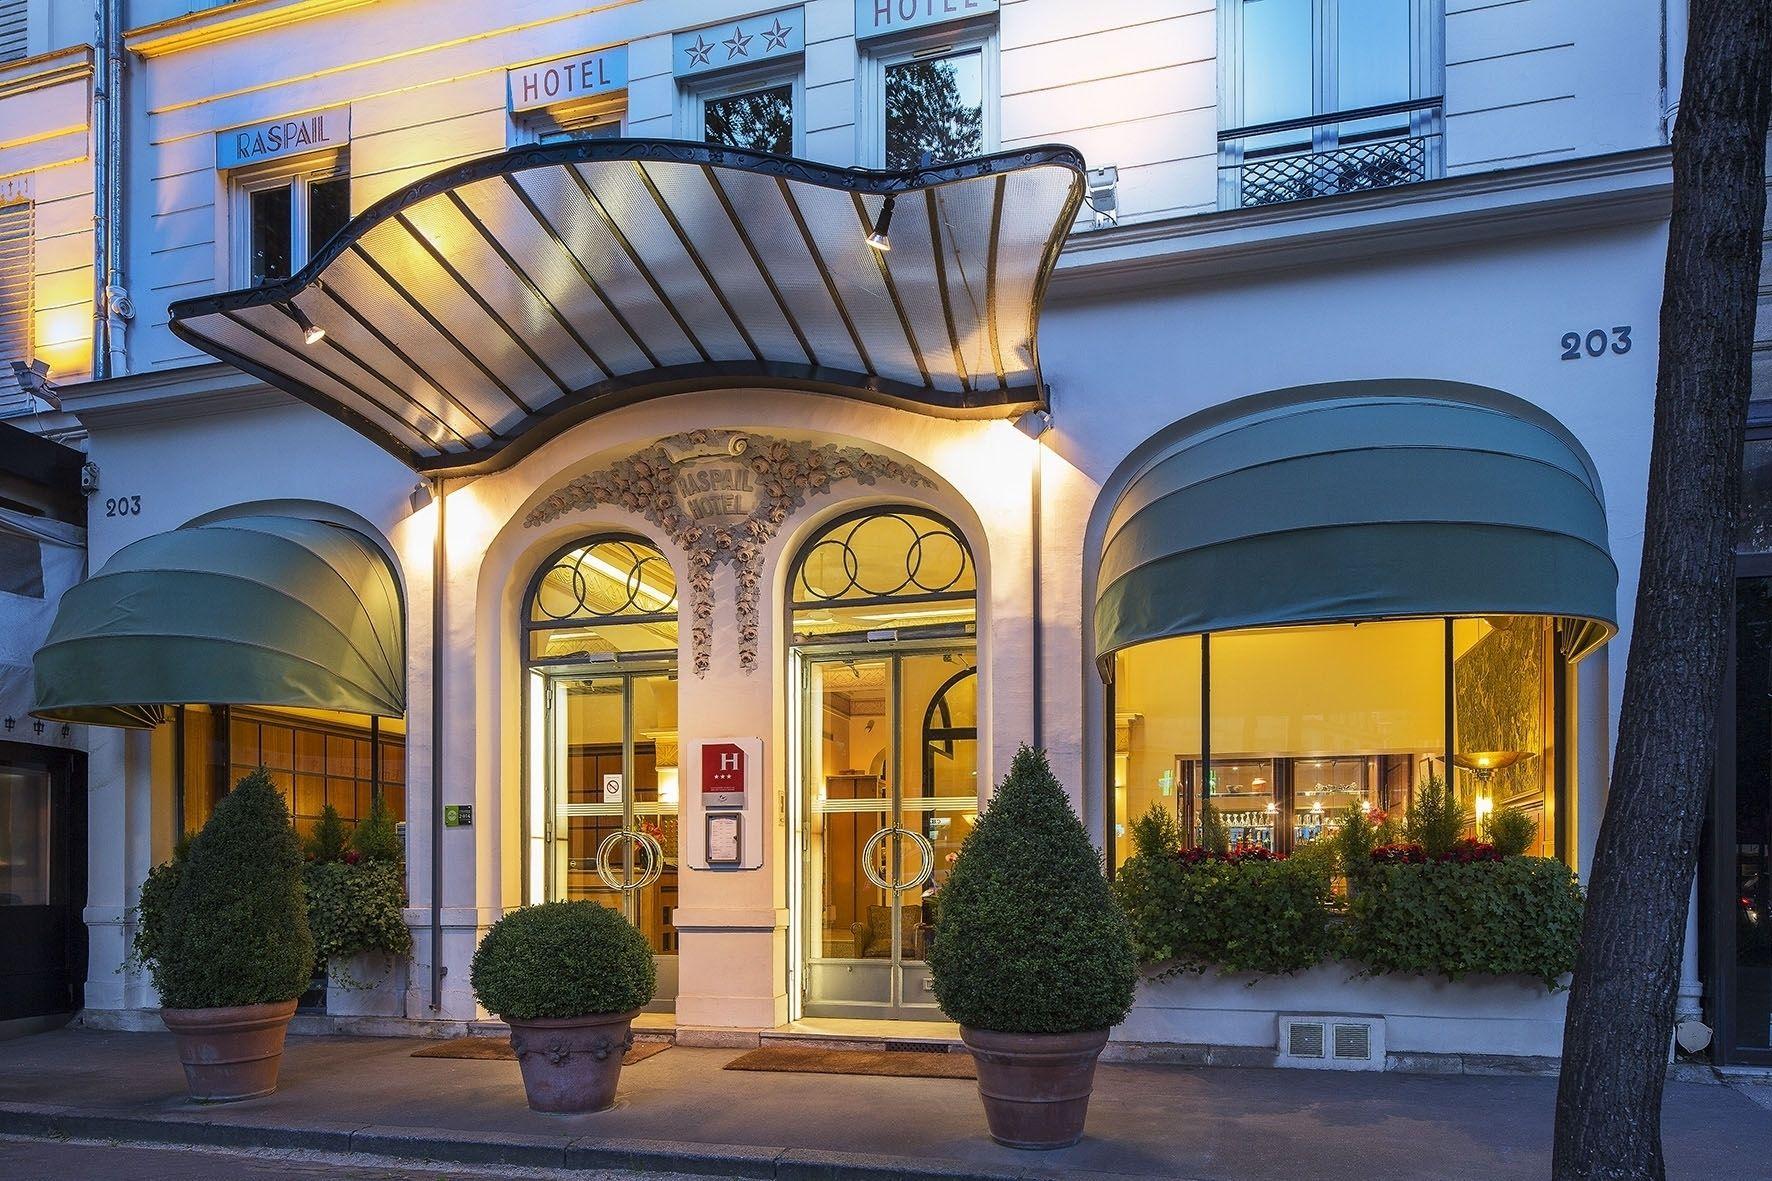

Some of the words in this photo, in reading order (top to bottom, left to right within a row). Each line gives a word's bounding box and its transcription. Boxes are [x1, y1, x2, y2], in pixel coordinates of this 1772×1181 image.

[874, 0, 978, 27] HOT
[523, 58, 611, 102] HOTEL
[236, 115, 330, 159] RASPAIL
[1560, 325, 1632, 361] 203
[106, 495, 141, 518] 203
[687, 494, 749, 520] HOTEL
[720, 752, 740, 771] H
